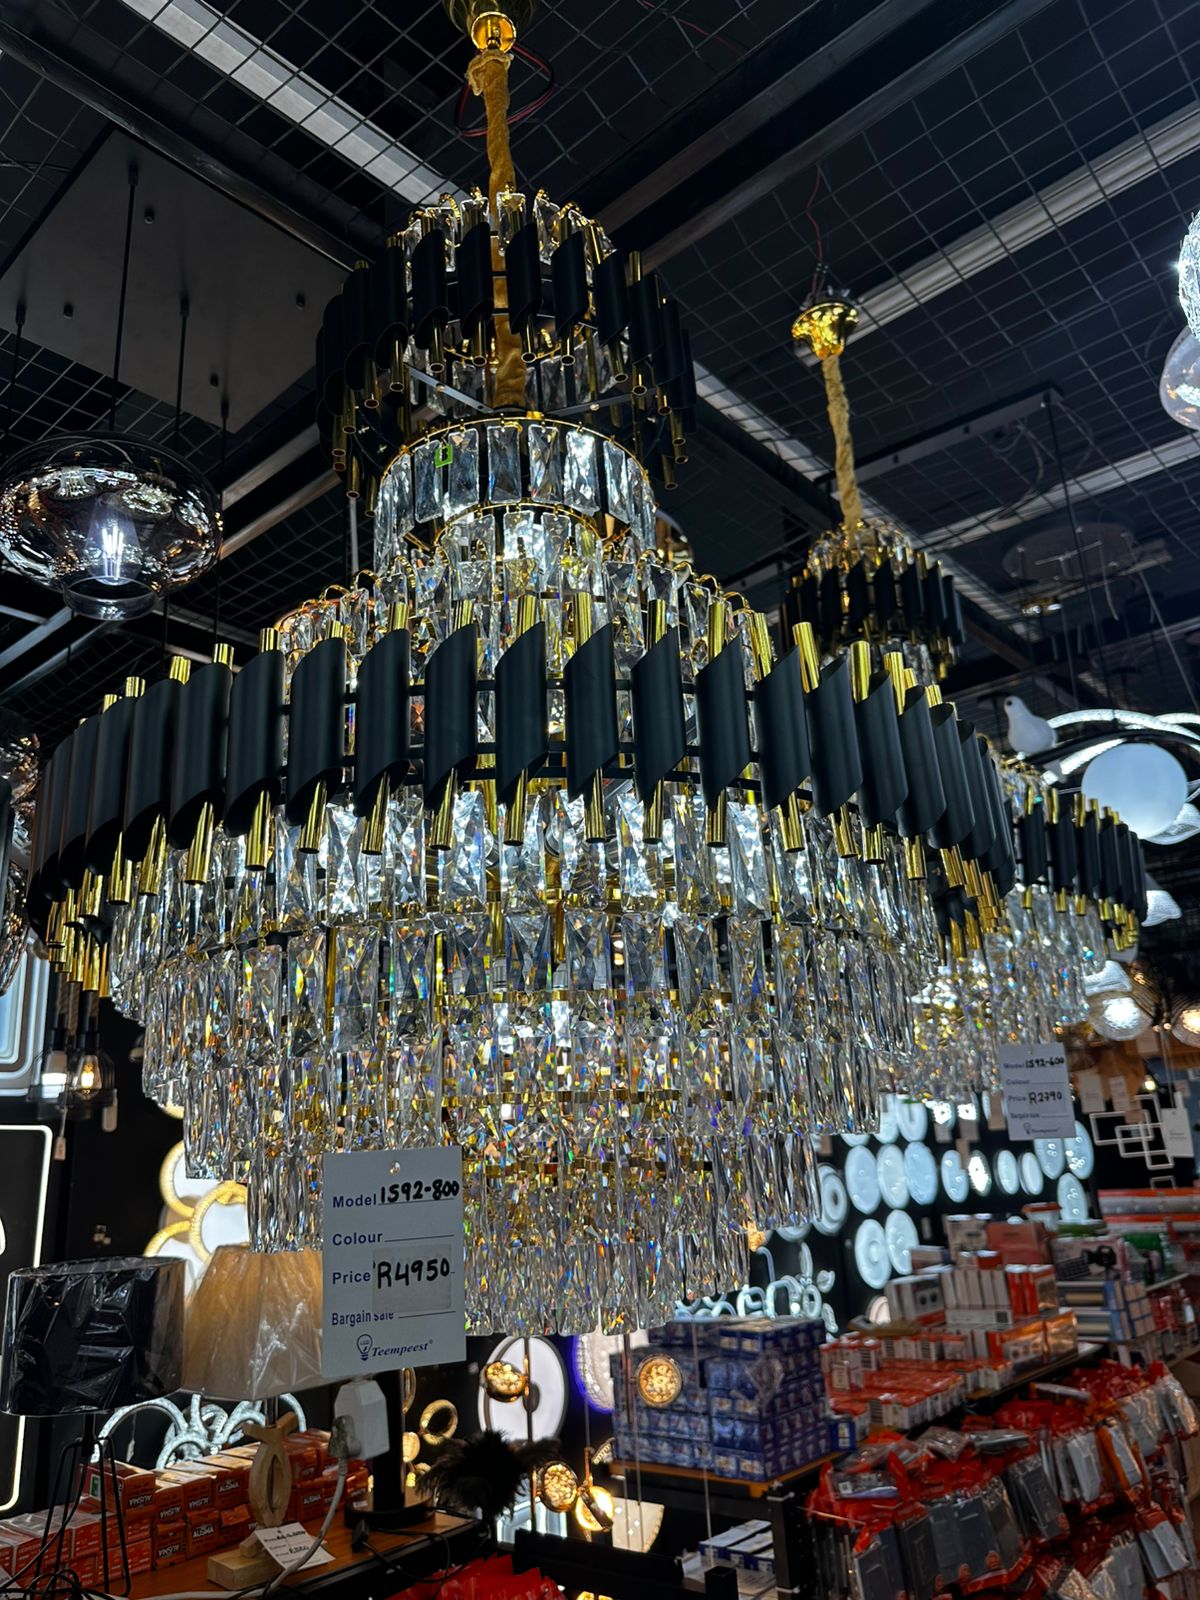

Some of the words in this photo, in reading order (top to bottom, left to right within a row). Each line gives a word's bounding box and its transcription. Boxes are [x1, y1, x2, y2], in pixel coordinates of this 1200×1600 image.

[332, 1193, 377, 1208] Model
[332, 1233, 383, 1246] Colour
[332, 1271, 371, 1284] Price
[377, 1257, 450, 1289] R4950
[331, 1309, 372, 1327] Bargain
